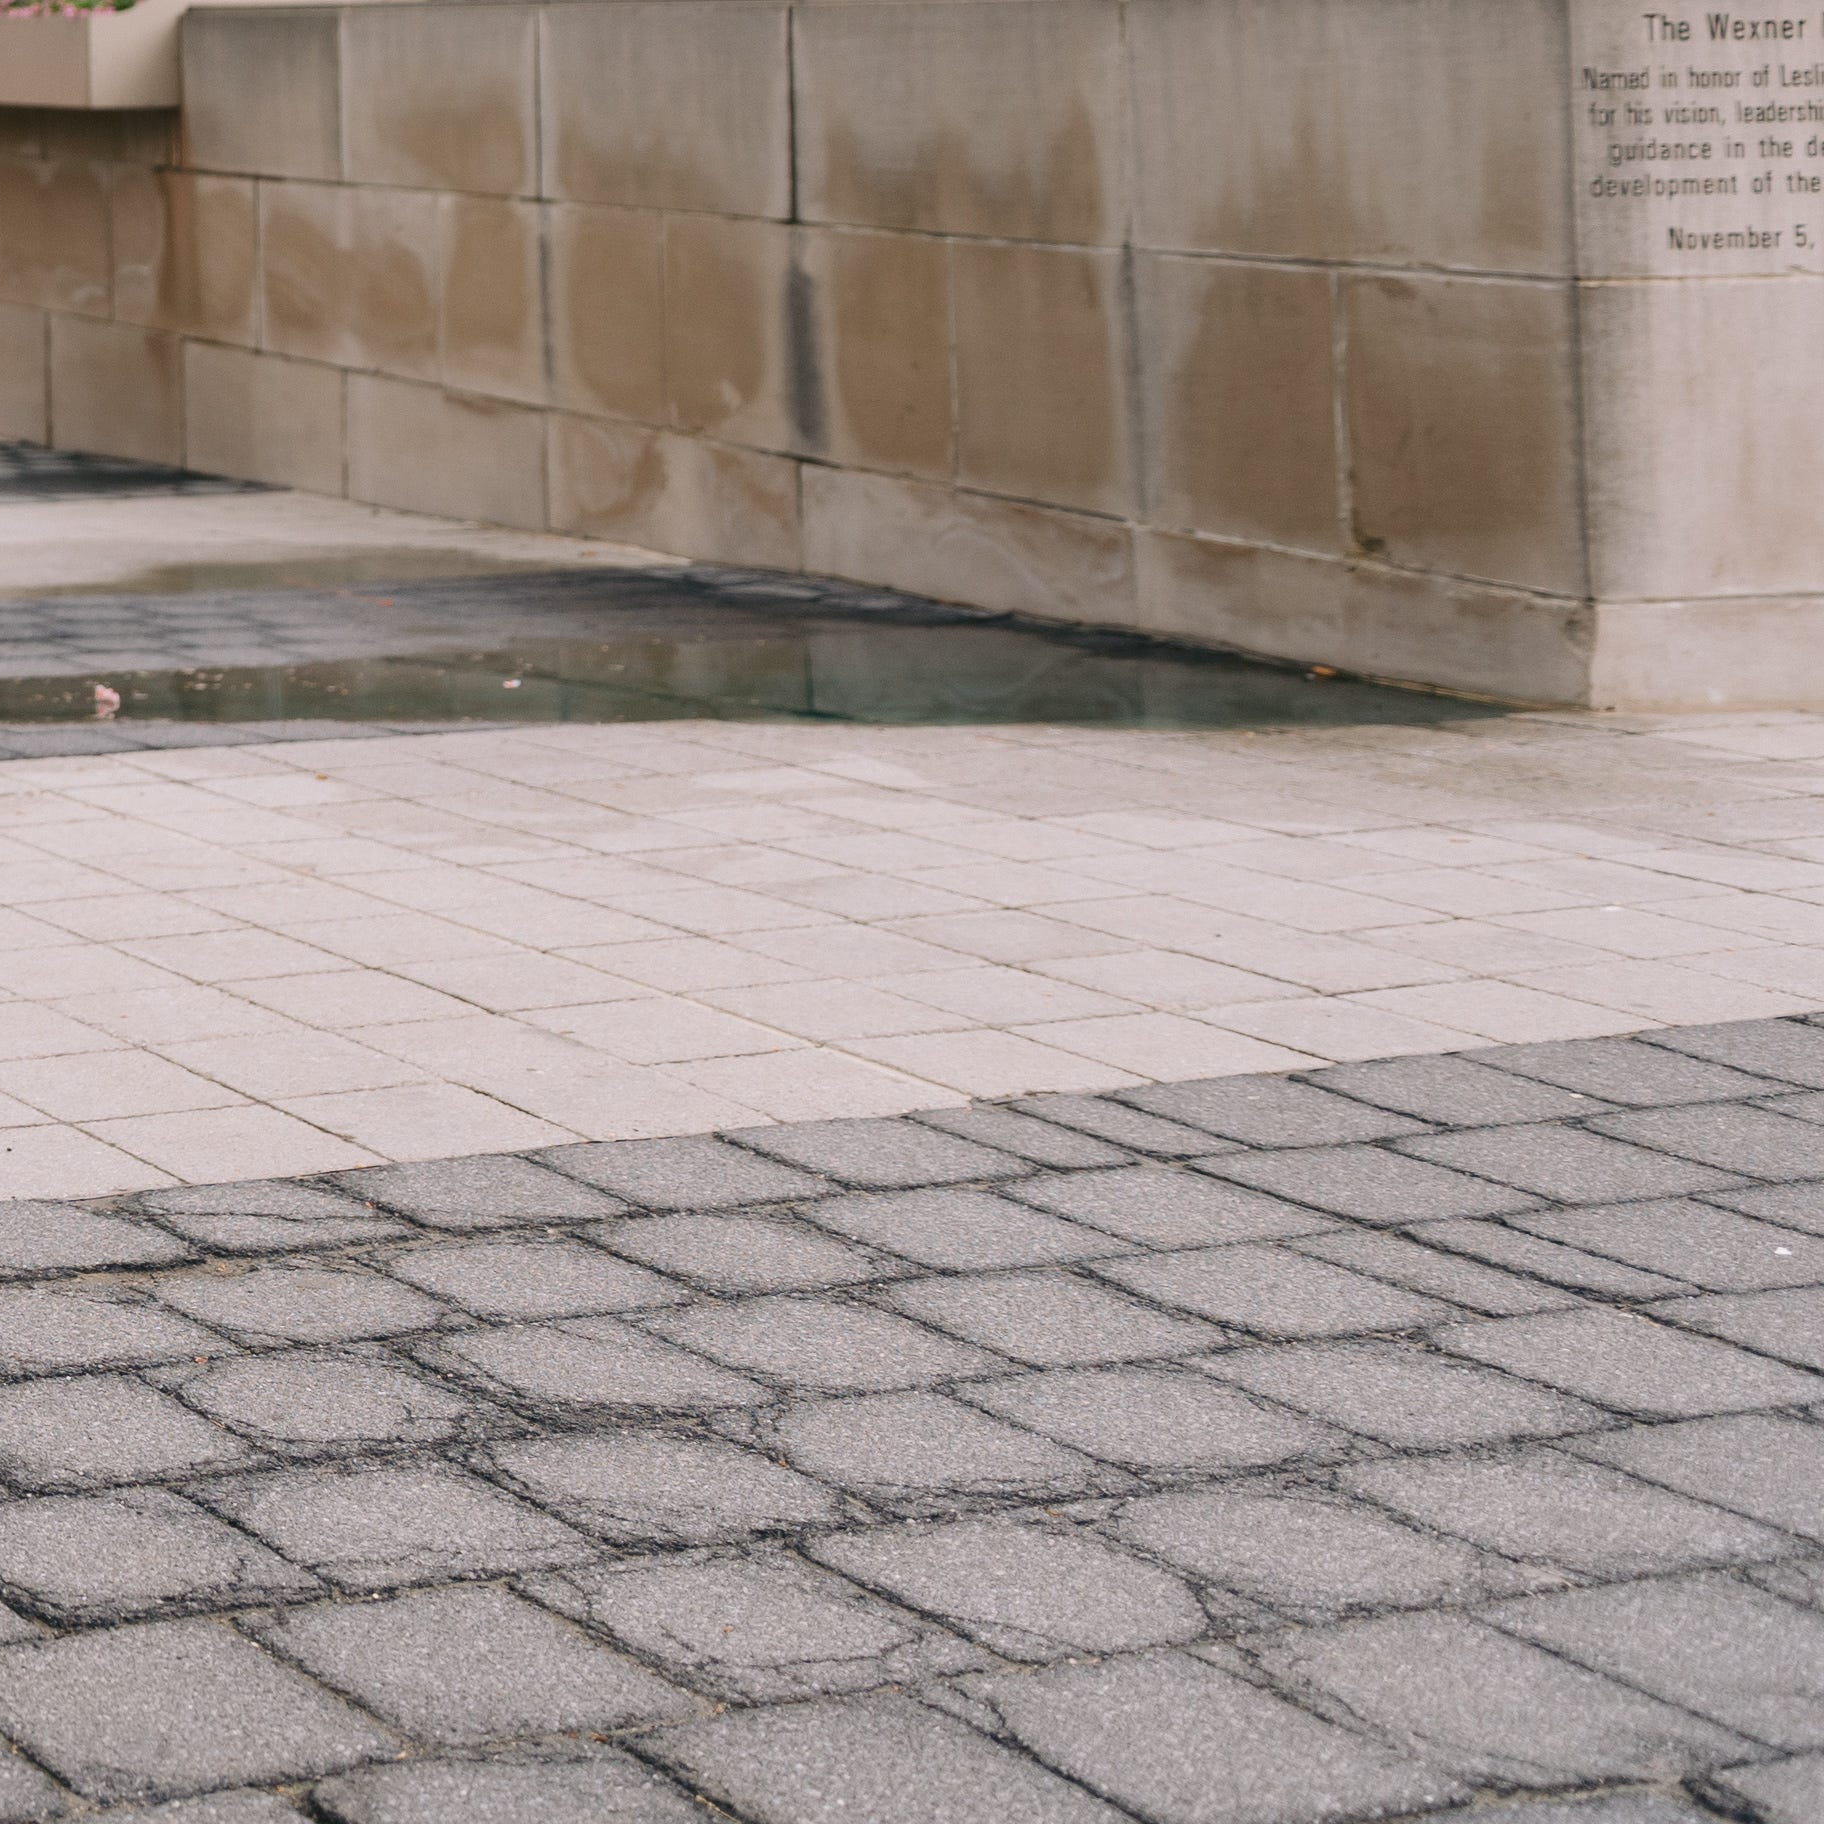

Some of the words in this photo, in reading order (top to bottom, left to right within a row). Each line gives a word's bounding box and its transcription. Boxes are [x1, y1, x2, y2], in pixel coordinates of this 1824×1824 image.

[1642, 13, 1690, 41] The
[1707, 13, 1806, 41] Wexner
[1582, 65, 1650, 90] Named
[1661, 65, 1678, 88] in
[1688, 64, 1741, 88] honor
[1752, 64, 1769, 88] of
[1779, 64, 1824, 88] Lesli
[1588, 101, 1615, 125] for
[1625, 100, 1652, 125] his
[1736, 99, 1824, 123] leadershi
[1608, 136, 1712, 166] guidance
[1724, 136, 1745, 159] in
[1759, 136, 1793, 159] the
[1590, 174, 1738, 200] development
[1752, 170, 1772, 195] of
[1786, 170, 1822, 194] the
[1668, 226, 1783, 250] November
[1795, 224, 1816, 251] 5,
